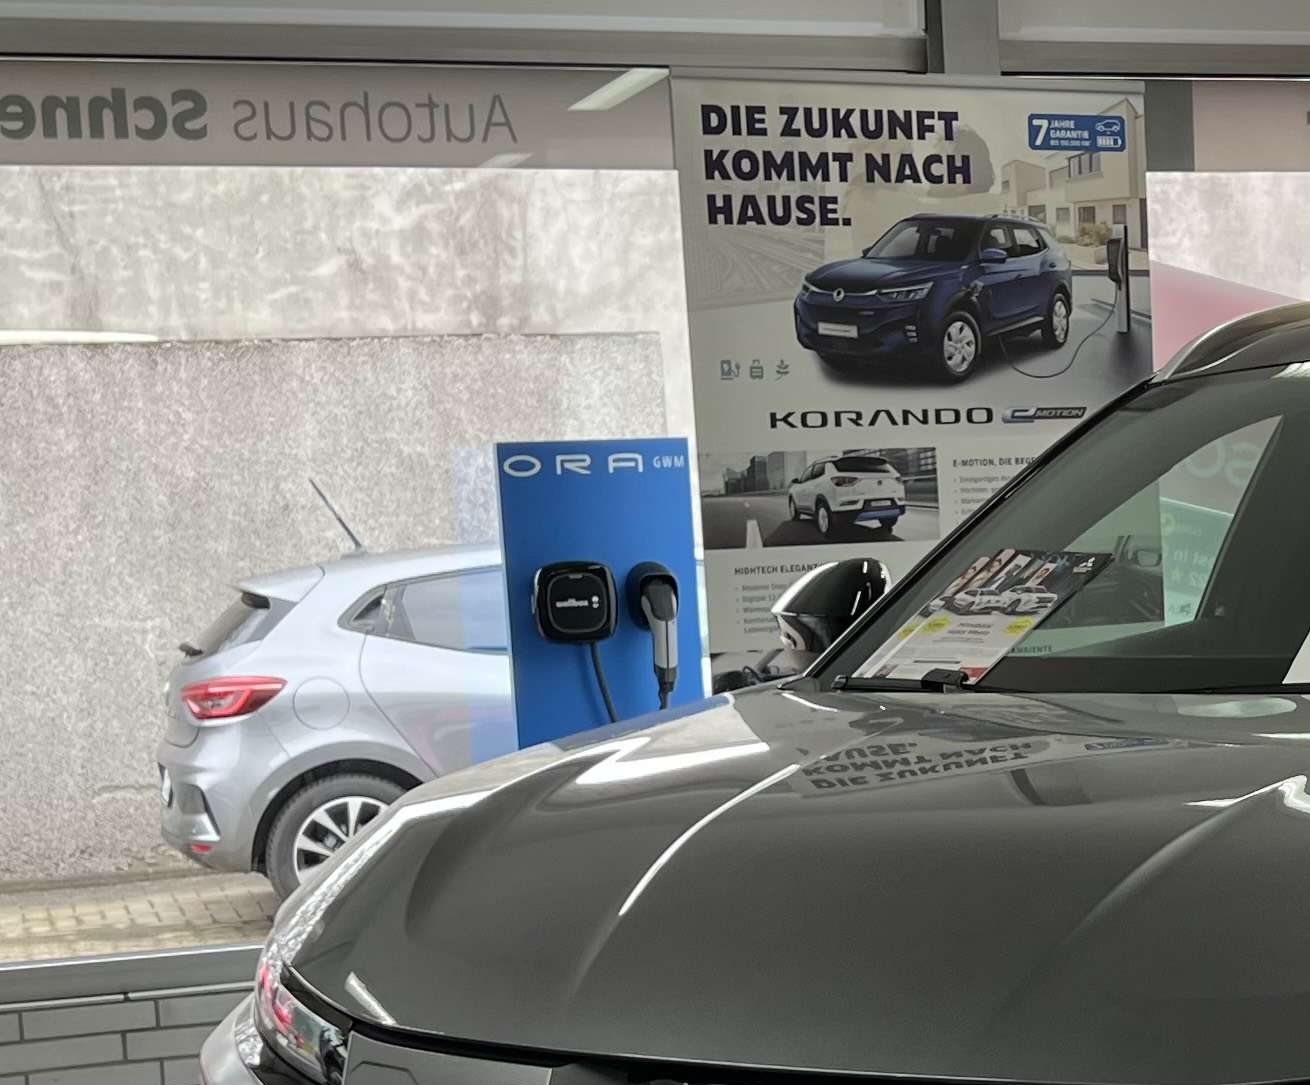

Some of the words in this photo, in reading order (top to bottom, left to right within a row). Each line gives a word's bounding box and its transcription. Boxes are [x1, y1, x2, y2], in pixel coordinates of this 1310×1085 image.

[700, 104, 769, 137] DIE
[779, 106, 960, 142] ZUKUNFT
[1031, 118, 1049, 146] 7
[704, 149, 854, 184] KOMMT
[865, 153, 972, 185] NACH
[708, 194, 852, 227] HAUSE.
[769, 406, 994, 429] KORANDO
[652, 454, 685, 469] GWM
